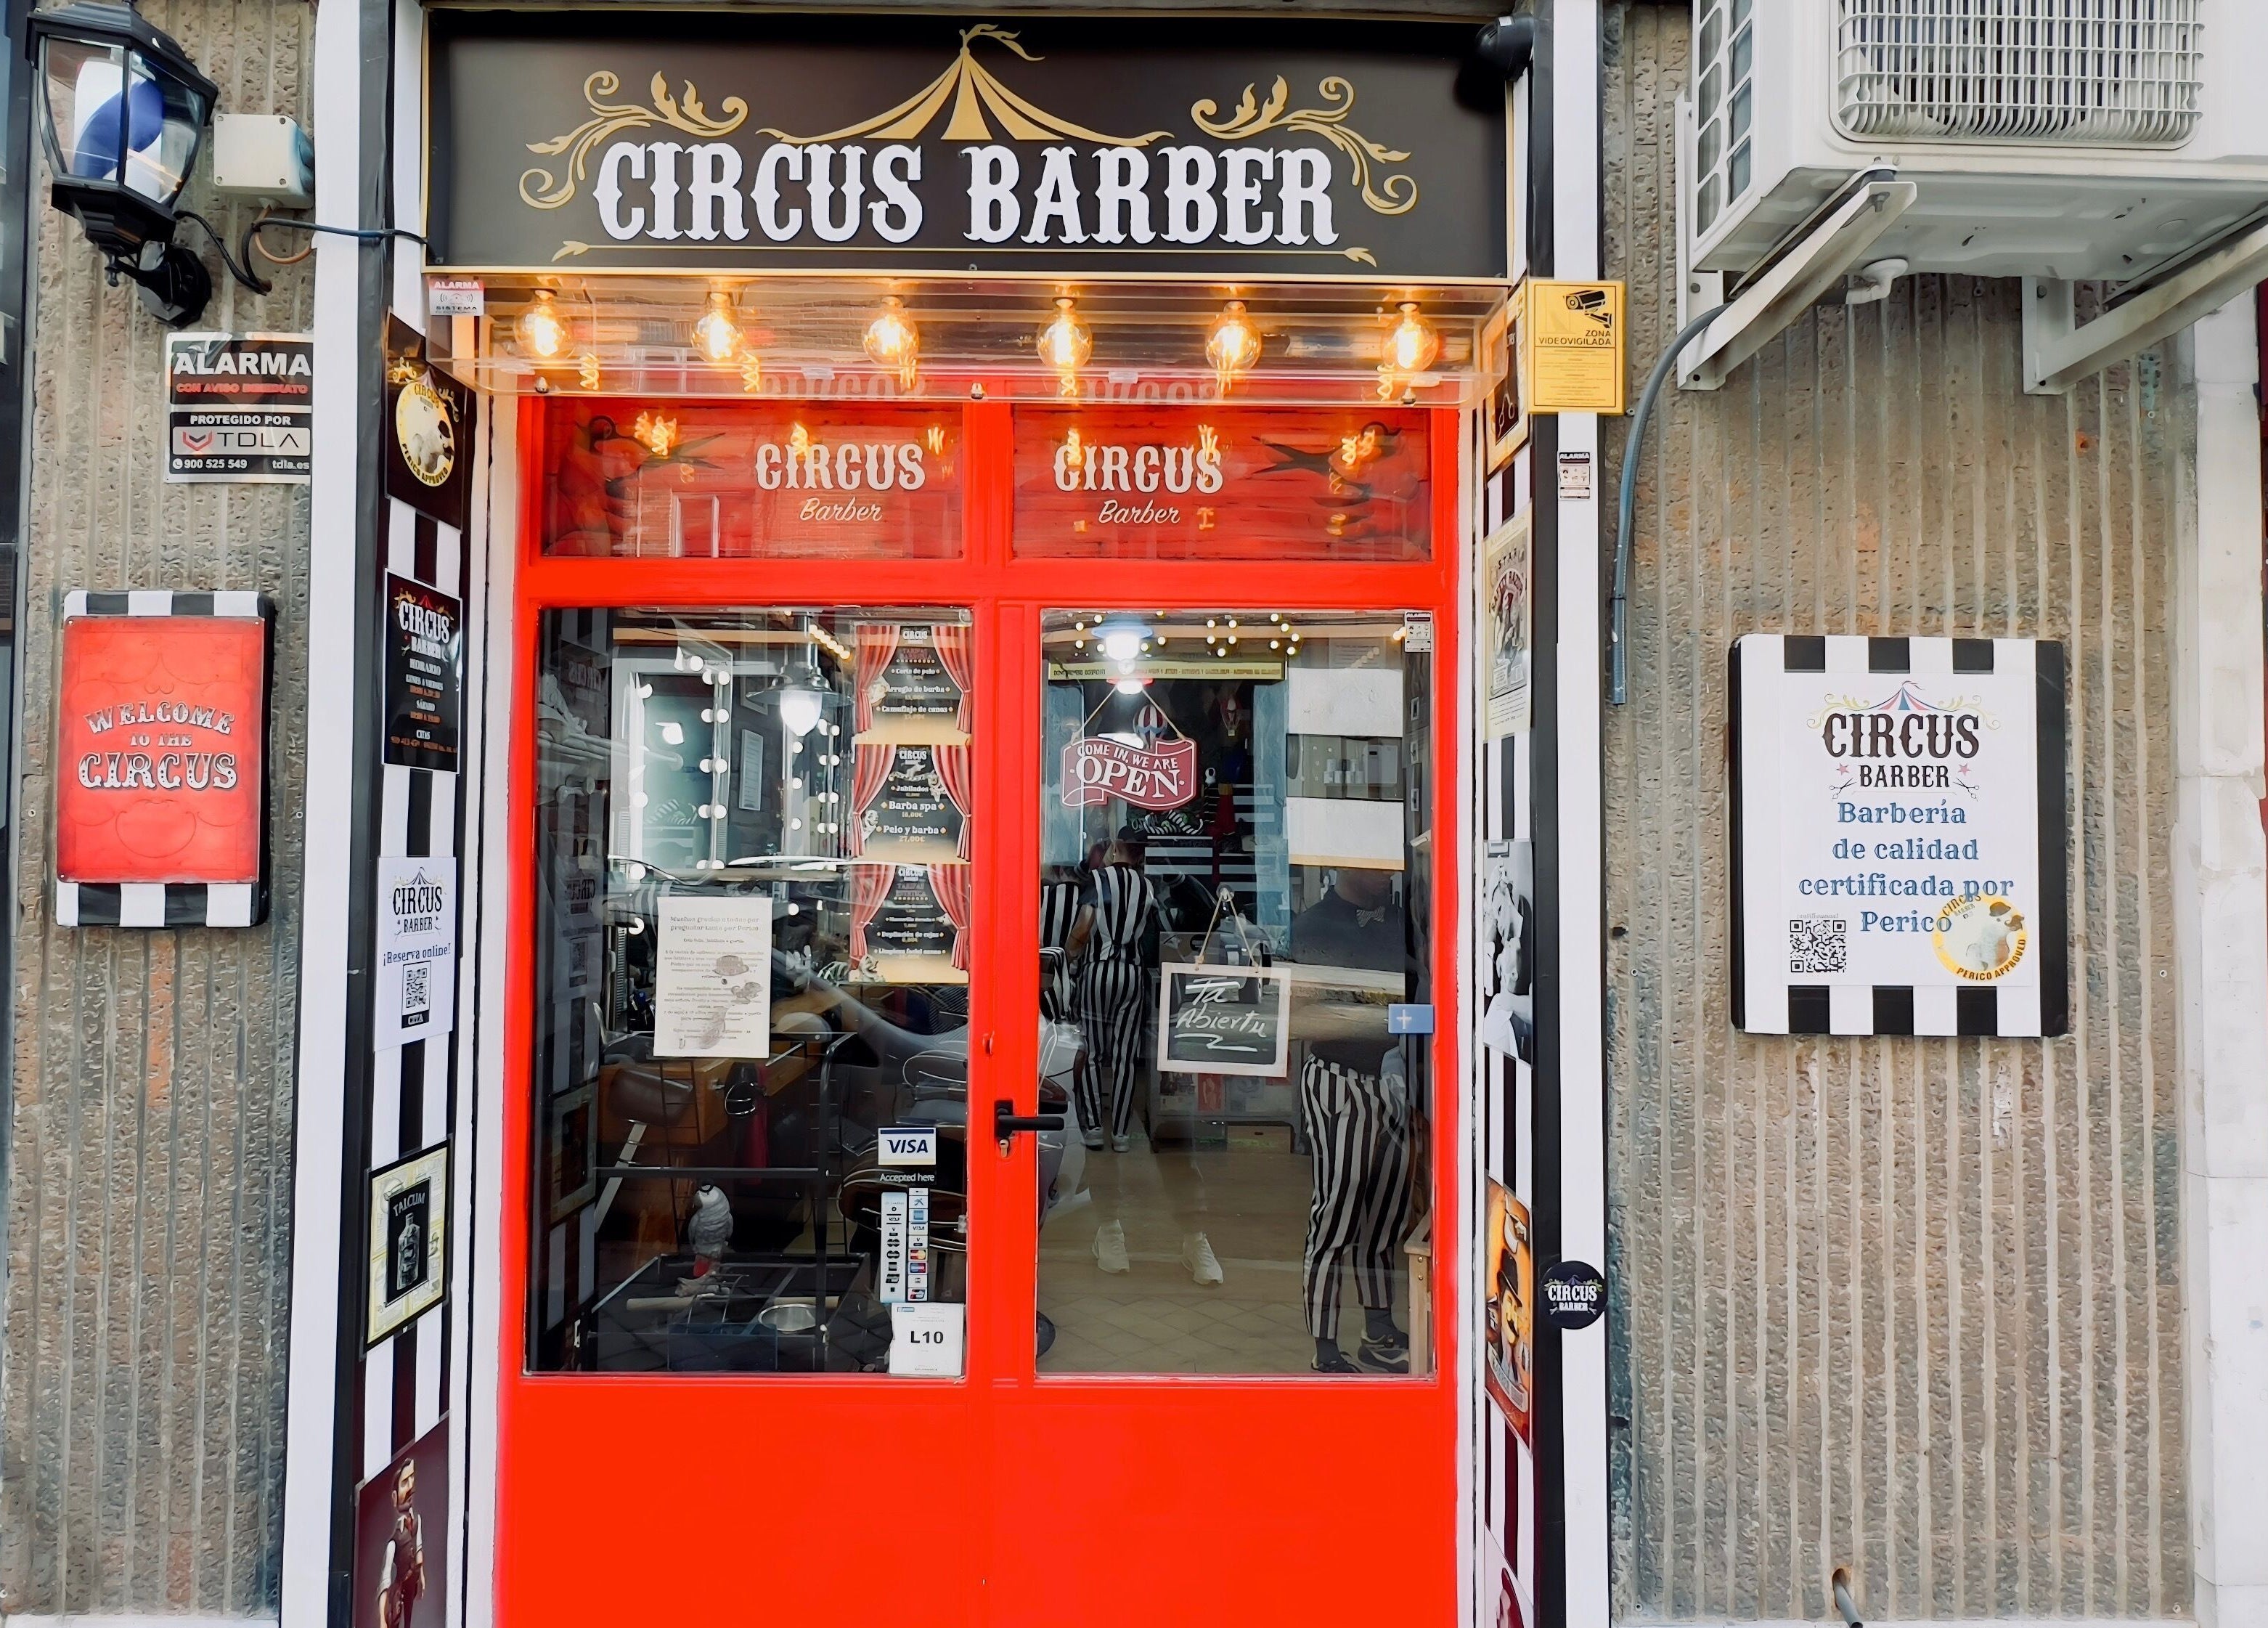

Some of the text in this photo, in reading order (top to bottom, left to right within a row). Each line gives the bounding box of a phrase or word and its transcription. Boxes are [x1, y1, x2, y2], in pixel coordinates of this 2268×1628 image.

[592, 142, 1341, 246] CIRCUS BARBER
[433, 280, 479, 289] ALARMA
[1538, 337, 1612, 346] VIDEOVIGILADA
[173, 352, 312, 376] ALARMA
[176, 383, 309, 394] CON AVISO INMEDIATO
[190, 415, 291, 426] PROTEGIDO POR
[217, 432, 299, 448] TDLA
[184, 459, 248, 469] 900 525 549
[272, 460, 310, 471] tdla.es
[755, 443, 926, 490] CIRCUS
[1052, 444, 1224, 494] CIRCUS
[799, 497, 883, 522] Barber
[1098, 498, 1180, 525] Barber
[399, 600, 449, 644] CIRCUS
[83, 700, 236, 736] WELCOME
[130, 731, 192, 747] TO THE
[1821, 712, 1980, 759] CIRCUS
[899, 750, 927, 760] CIRCUS
[1077, 744, 1178, 770] COME IN, WE ARE
[78, 752, 238, 790] CIRCUS
[1076, 755, 1180, 798] OPEN
[1859, 765, 1950, 789] BARBER
[889, 801, 937, 813] Barba spa
[1837, 799, 1966, 824] Barbería
[883, 825, 903, 834] Pelo
[912, 826, 939, 834] barba
[1832, 837, 1979, 860] de calidad
[1798, 874, 2014, 902] certificada por
[392, 885, 443, 915] CIRCUS
[404, 916, 433, 932] BARBER
[1860, 911, 1952, 933] Perico
[383, 943, 452, 966] ¡Reserva online!
[1957, 939, 2026, 980] PERICO APPROVED
[887, 1139, 929, 1154] VISA
[879, 1173, 935, 1183] Accepted here
[393, 1192, 426, 1217] TALCUM
[1547, 1285, 1597, 1302] CIRCUS
[910, 1331, 944, 1344] L10
